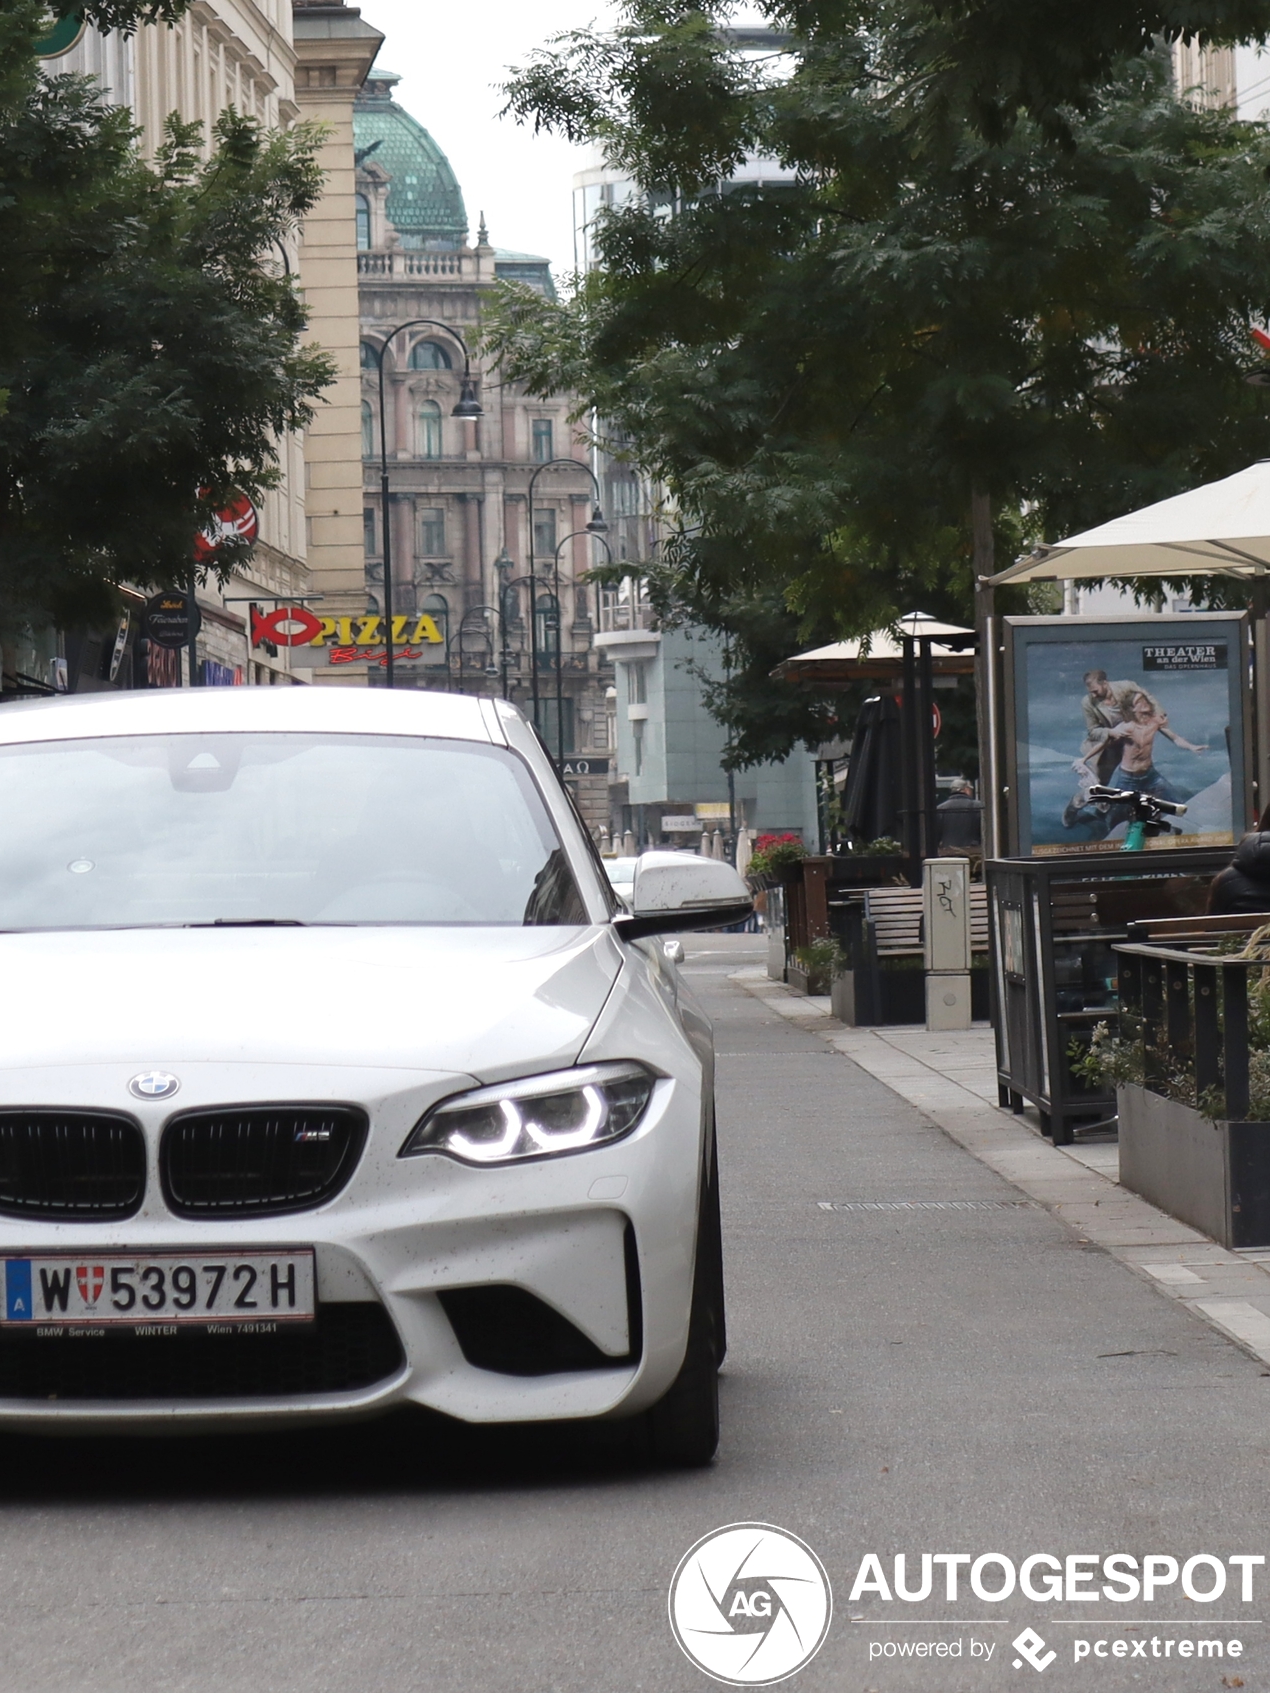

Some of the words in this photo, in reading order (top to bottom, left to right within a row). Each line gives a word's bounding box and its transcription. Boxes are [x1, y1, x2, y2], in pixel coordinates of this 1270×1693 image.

[310, 614, 444, 647] PIZZA
[1144, 646, 1217, 658] THEATER
[1156, 656, 1170, 664] an
[1171, 655, 1189, 664] der
[1190, 654, 1216, 663] Wien
[14, 1298, 26, 1312] A
[36, 1328, 63, 1337] BMW
[68, 1327, 106, 1337] Service
[135, 1325, 178, 1336] WINTER
[207, 1324, 232, 1335] Wien
[236, 1323, 277, 1334] 7491341
